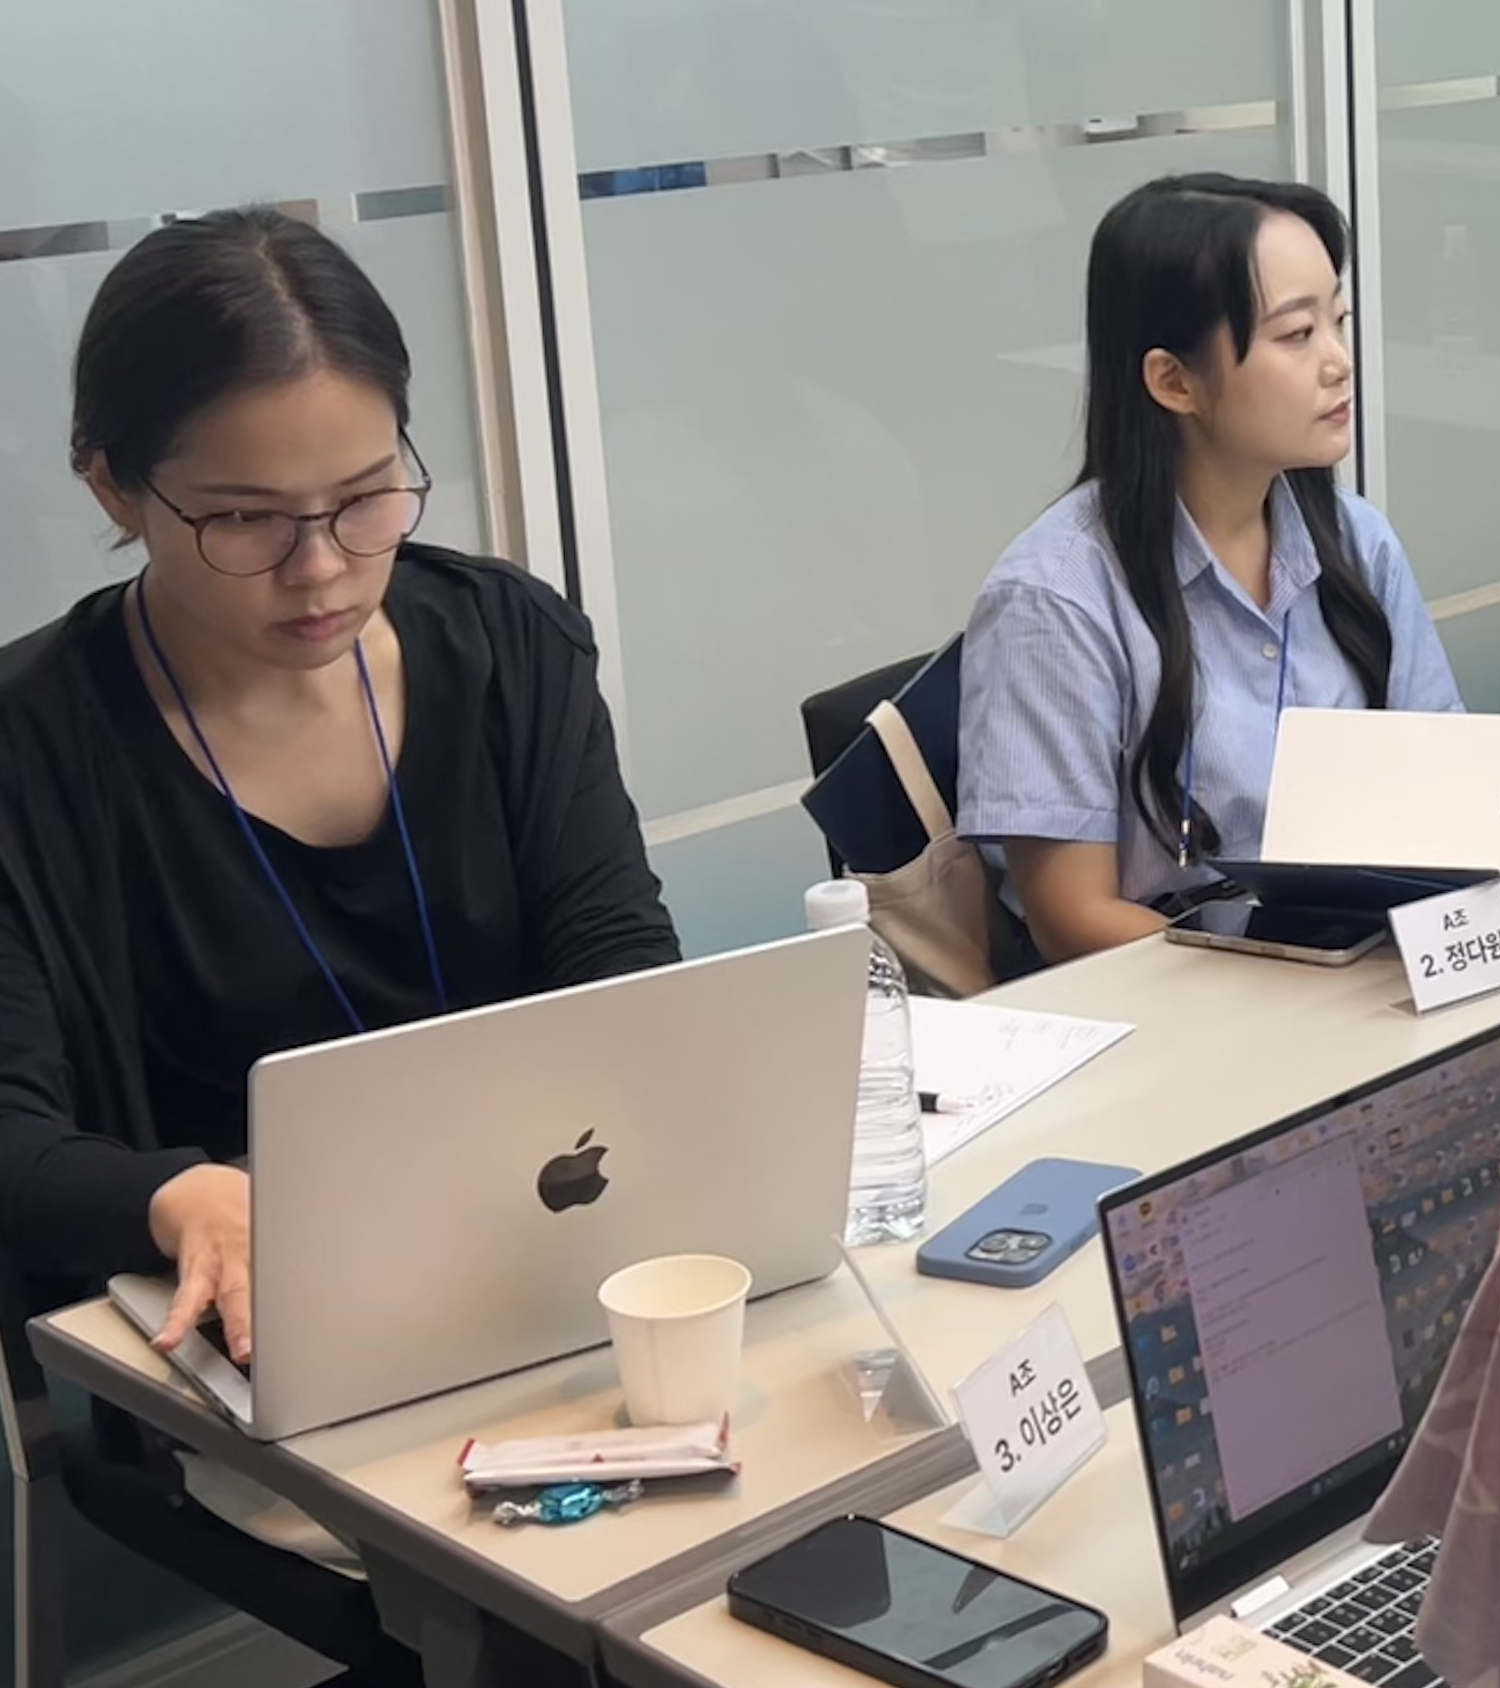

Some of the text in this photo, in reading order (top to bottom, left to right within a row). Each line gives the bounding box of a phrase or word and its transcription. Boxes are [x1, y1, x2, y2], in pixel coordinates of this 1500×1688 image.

[1443, 908, 1469, 931] A조
[1420, 954, 1444, 978] 2.
[1009, 1359, 1037, 1396] A조
[995, 1378, 1082, 1472] 3. 이상은
